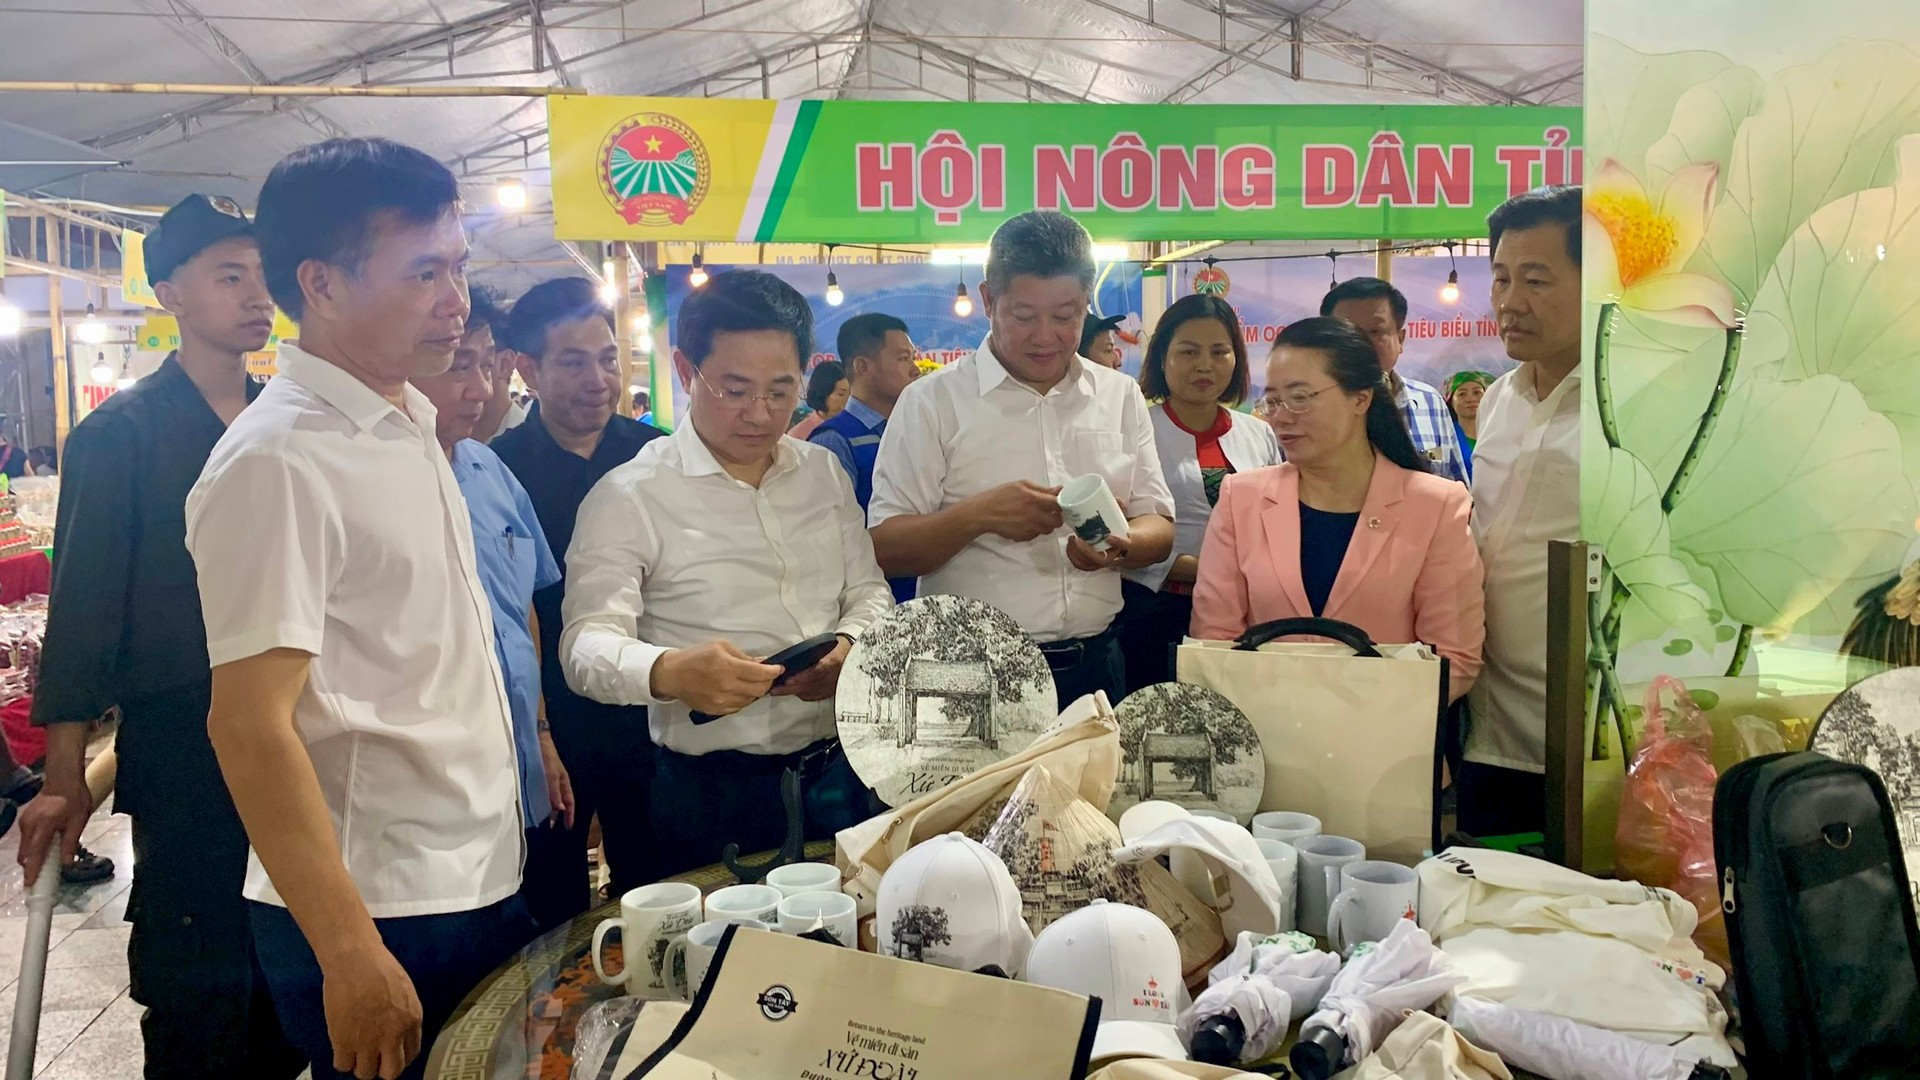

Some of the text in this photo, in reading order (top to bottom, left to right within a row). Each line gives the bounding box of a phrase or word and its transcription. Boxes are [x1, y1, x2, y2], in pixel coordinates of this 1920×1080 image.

[856, 129, 1006, 225] HỘI
[1034, 131, 1276, 212] NÔNG
[1302, 130, 1473, 208] DÂN
[1407, 312, 1498, 338] TIÊU BIỂU TỈN
[848, 1020, 926, 1045] Return to the heritage land
[859, 1035, 887, 1053] miền
